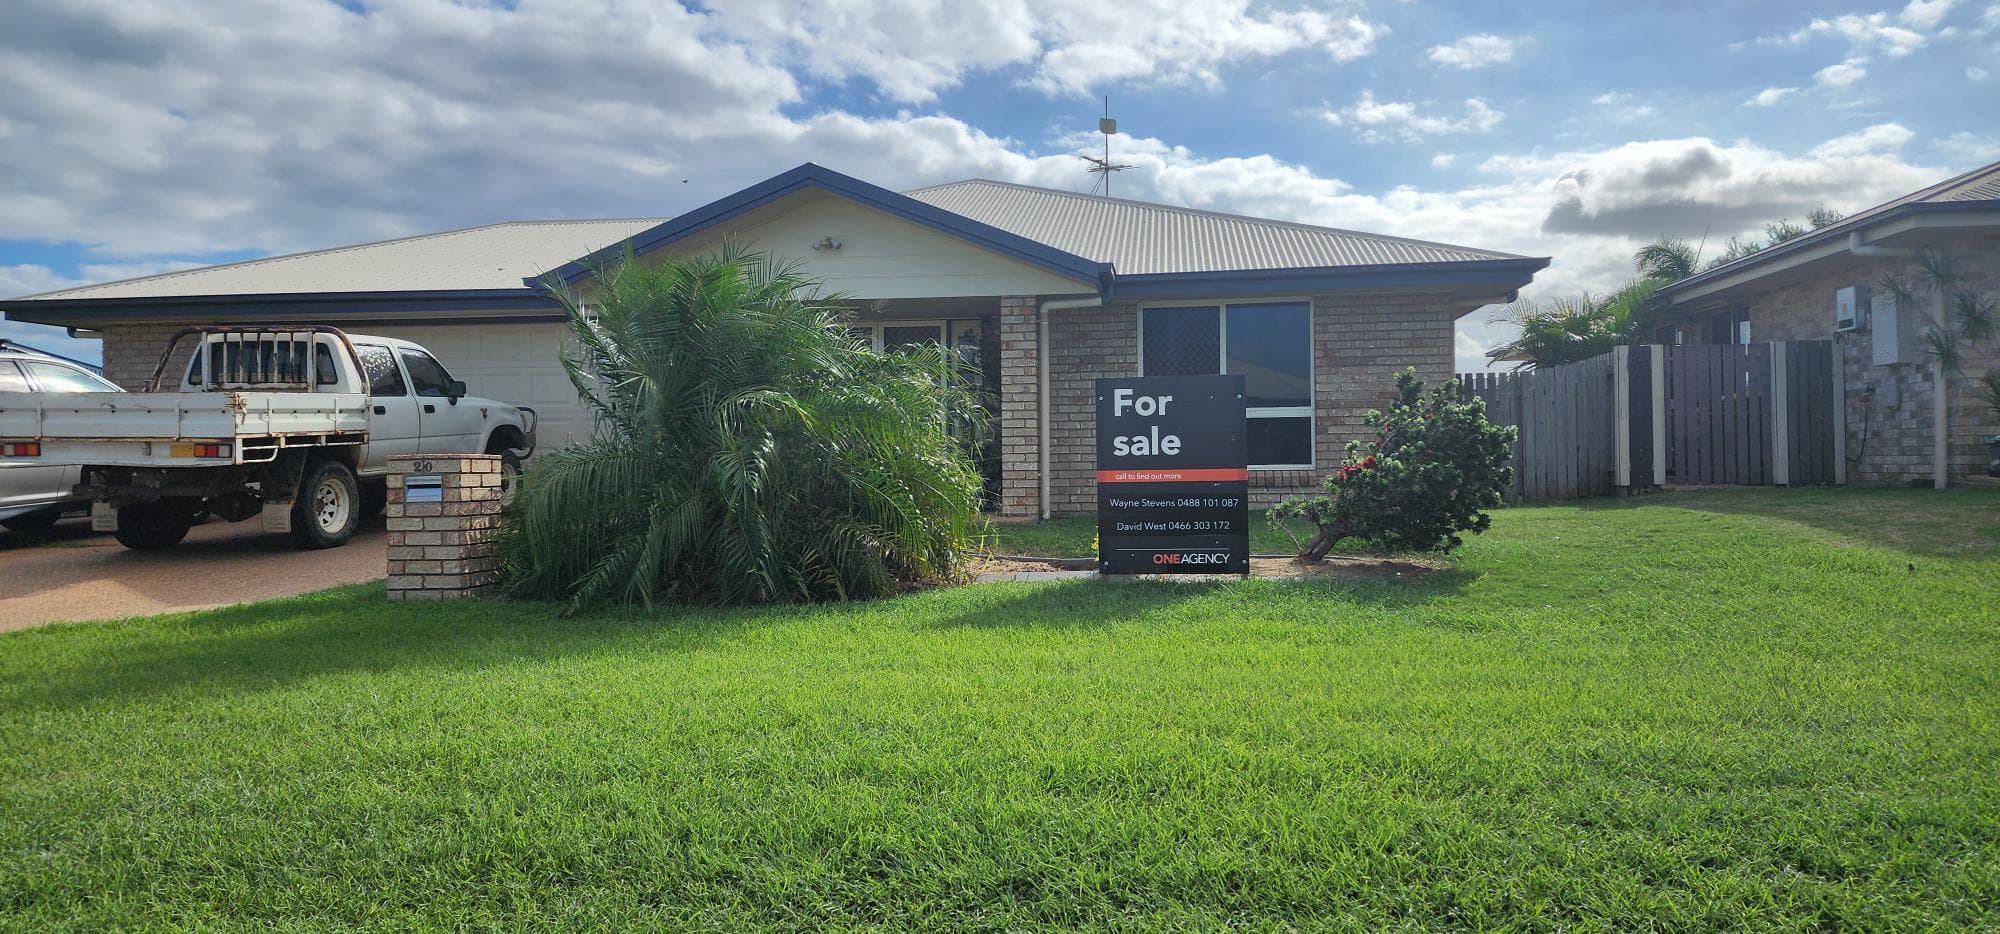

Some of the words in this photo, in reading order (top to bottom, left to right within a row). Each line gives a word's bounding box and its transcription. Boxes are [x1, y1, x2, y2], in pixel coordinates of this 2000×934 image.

[1114, 388, 1173, 417] For
[1113, 425, 1181, 457] sale
[1110, 499, 1140, 508] Wayne
[1141, 499, 1176, 507] Stevens
[1177, 499, 1201, 507] 0488
[1203, 499, 1219, 507] 101
[1221, 499, 1238, 507] 087
[1116, 522, 1143, 531] David
[1144, 522, 1167, 531] West
[1168, 521, 1192, 530] 0466
[1193, 521, 1211, 530] 303
[1213, 521, 1230, 530] 172
